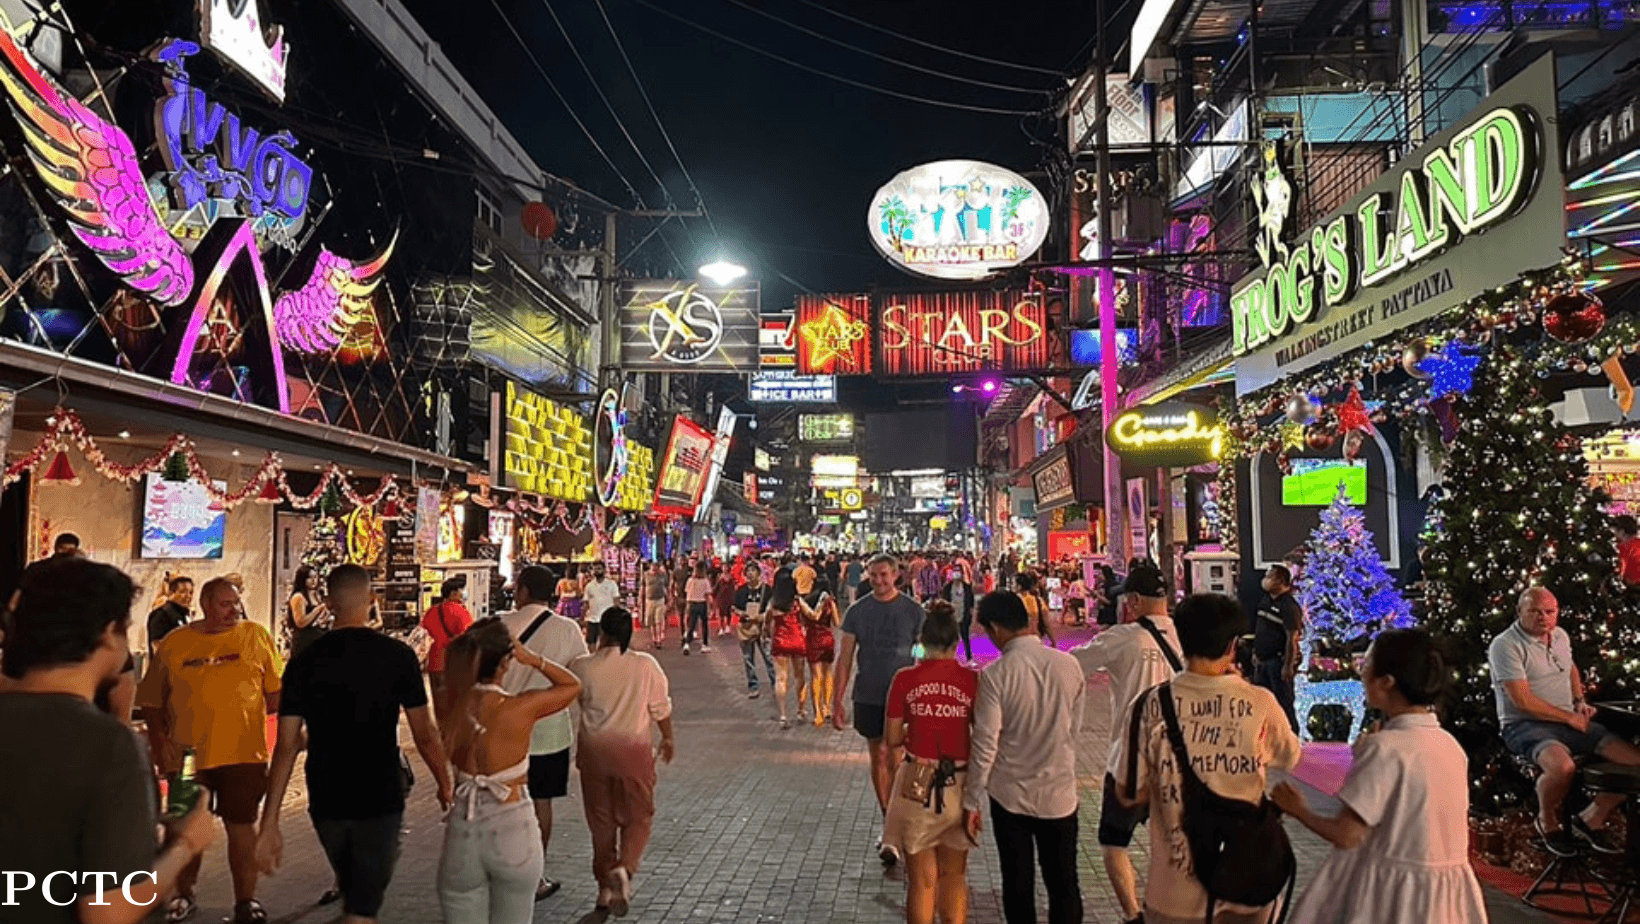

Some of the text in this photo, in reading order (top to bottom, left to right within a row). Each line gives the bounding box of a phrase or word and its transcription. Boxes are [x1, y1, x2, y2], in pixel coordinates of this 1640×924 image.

[1231, 215, 1350, 356] FROG'S
[1358, 107, 1524, 287] LAND
[904, 244, 1017, 263] KARAOKE BAR
[1381, 268, 1454, 320] PATTAYA
[801, 319, 865, 341] STARS
[882, 300, 1043, 350] STARS
[910, 703, 968, 718] SEA ZONE
[1190, 694, 1222, 719] WAIT
[1229, 697, 1253, 719] FOR
